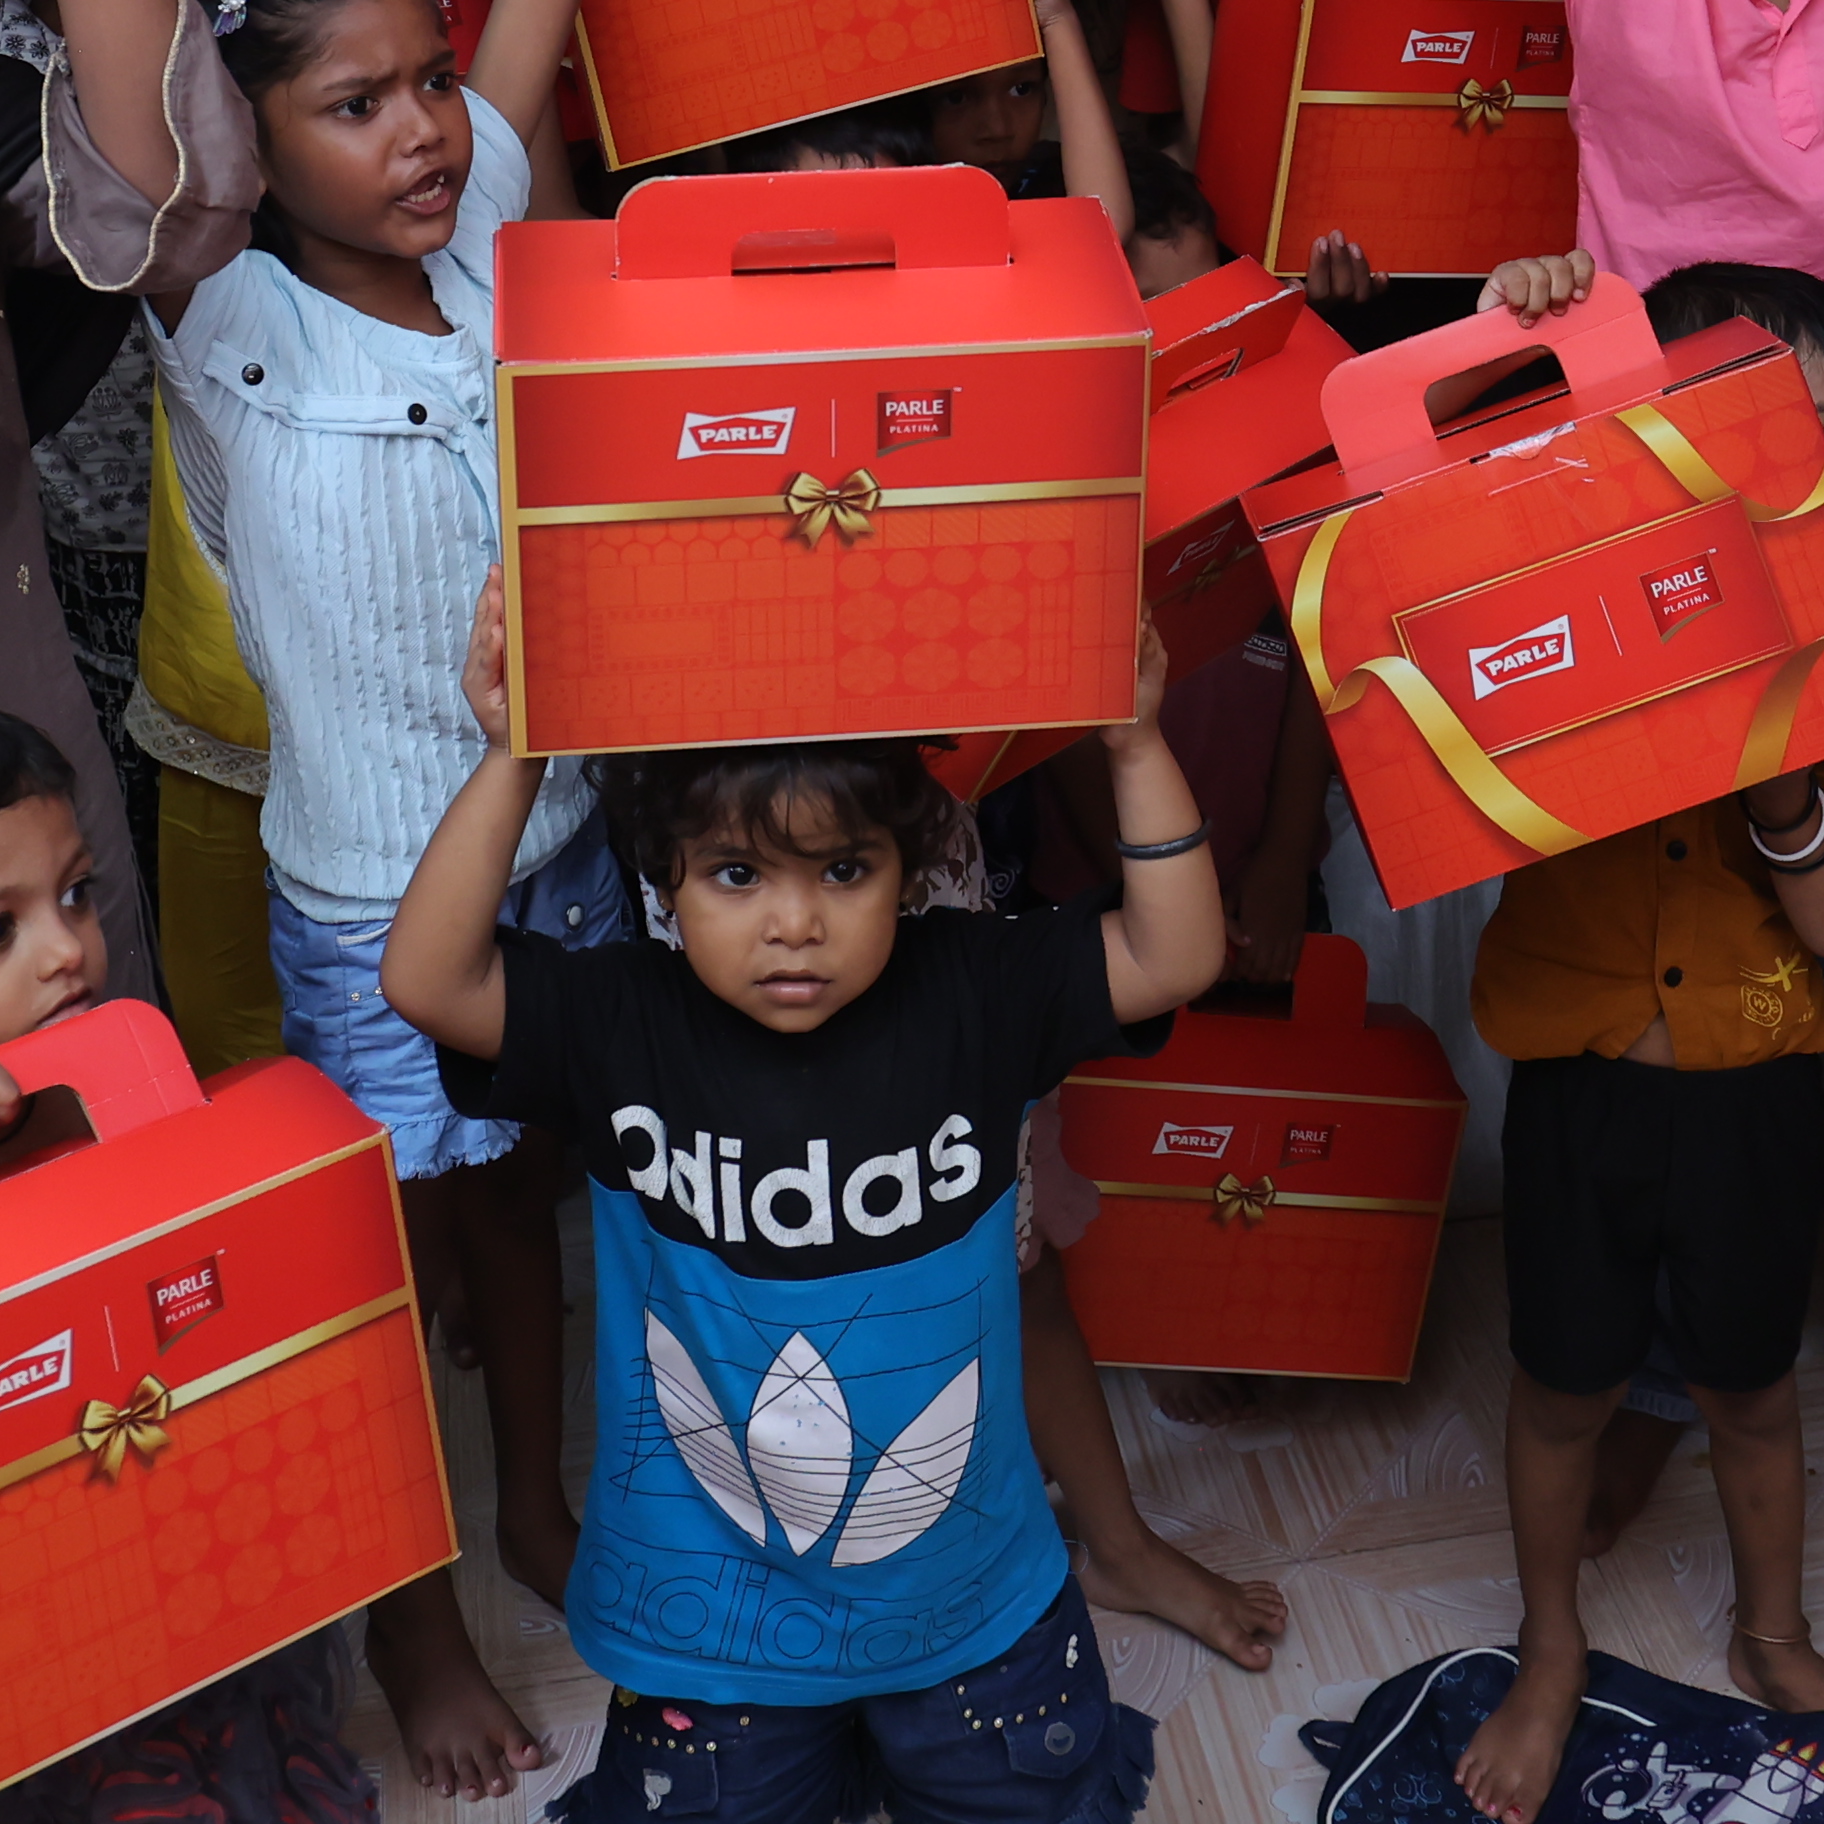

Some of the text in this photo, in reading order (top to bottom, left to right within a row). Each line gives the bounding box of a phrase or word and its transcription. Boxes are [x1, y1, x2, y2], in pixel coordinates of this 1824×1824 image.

[1526, 32, 1559, 44] PARLE
[1416, 41, 1461, 53] PARLE
[885, 399, 944, 416] PARLE
[698, 425, 777, 443] PARLE
[889, 423, 939, 434] PLATINA
[1650, 566, 1708, 599] PARLE
[1663, 593, 1710, 615] PLATINA
[1486, 638, 1560, 677] PARLE
[1169, 1134, 1219, 1147] PARLE
[1290, 1129, 1328, 1143] PARLE
[1290, 1147, 1322, 1155] PLATINA
[610, 1104, 982, 1249] adidas
[156, 1269, 212, 1306] PARLE
[165, 1299, 211, 1324] PLATINA
